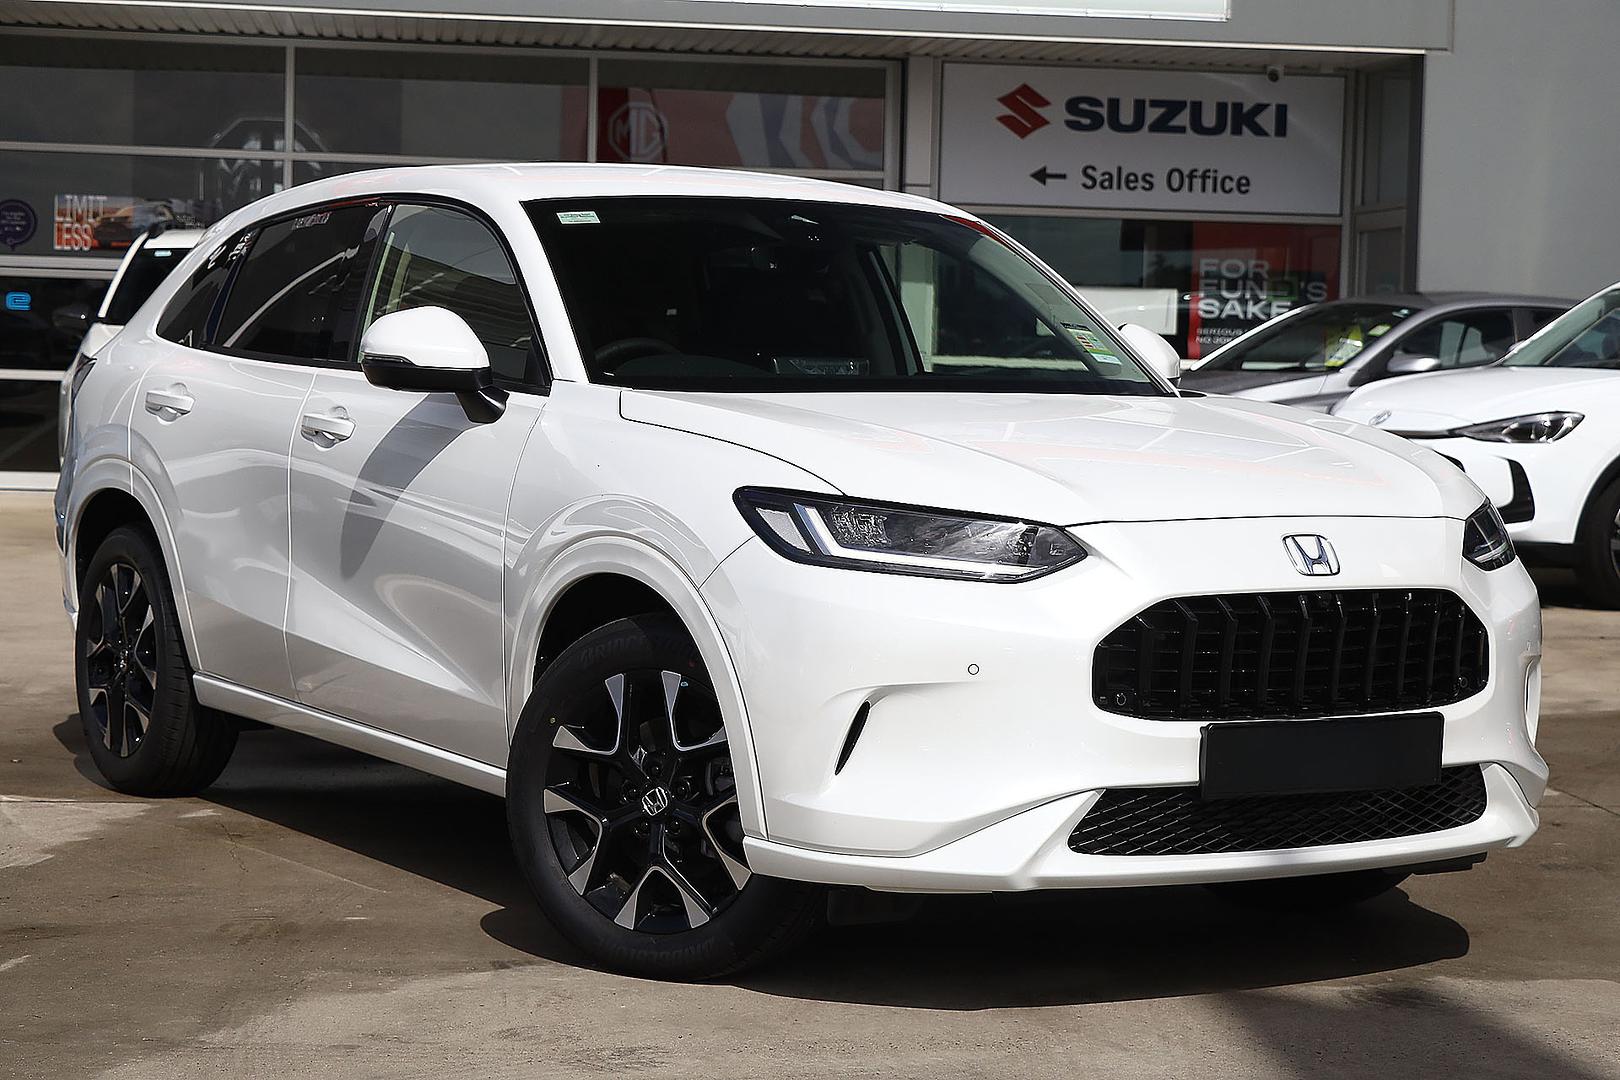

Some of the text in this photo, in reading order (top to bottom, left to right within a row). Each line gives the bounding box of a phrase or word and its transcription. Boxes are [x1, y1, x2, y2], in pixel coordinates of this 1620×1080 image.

[1063, 96, 1288, 138] SUZUKI
[1081, 164, 1251, 195] Sales Office
[54, 194, 107, 222] LIMIT
[54, 223, 92, 251] LESS
[1199, 258, 1270, 278] FOR
[1197, 299, 1292, 321] SAKE
